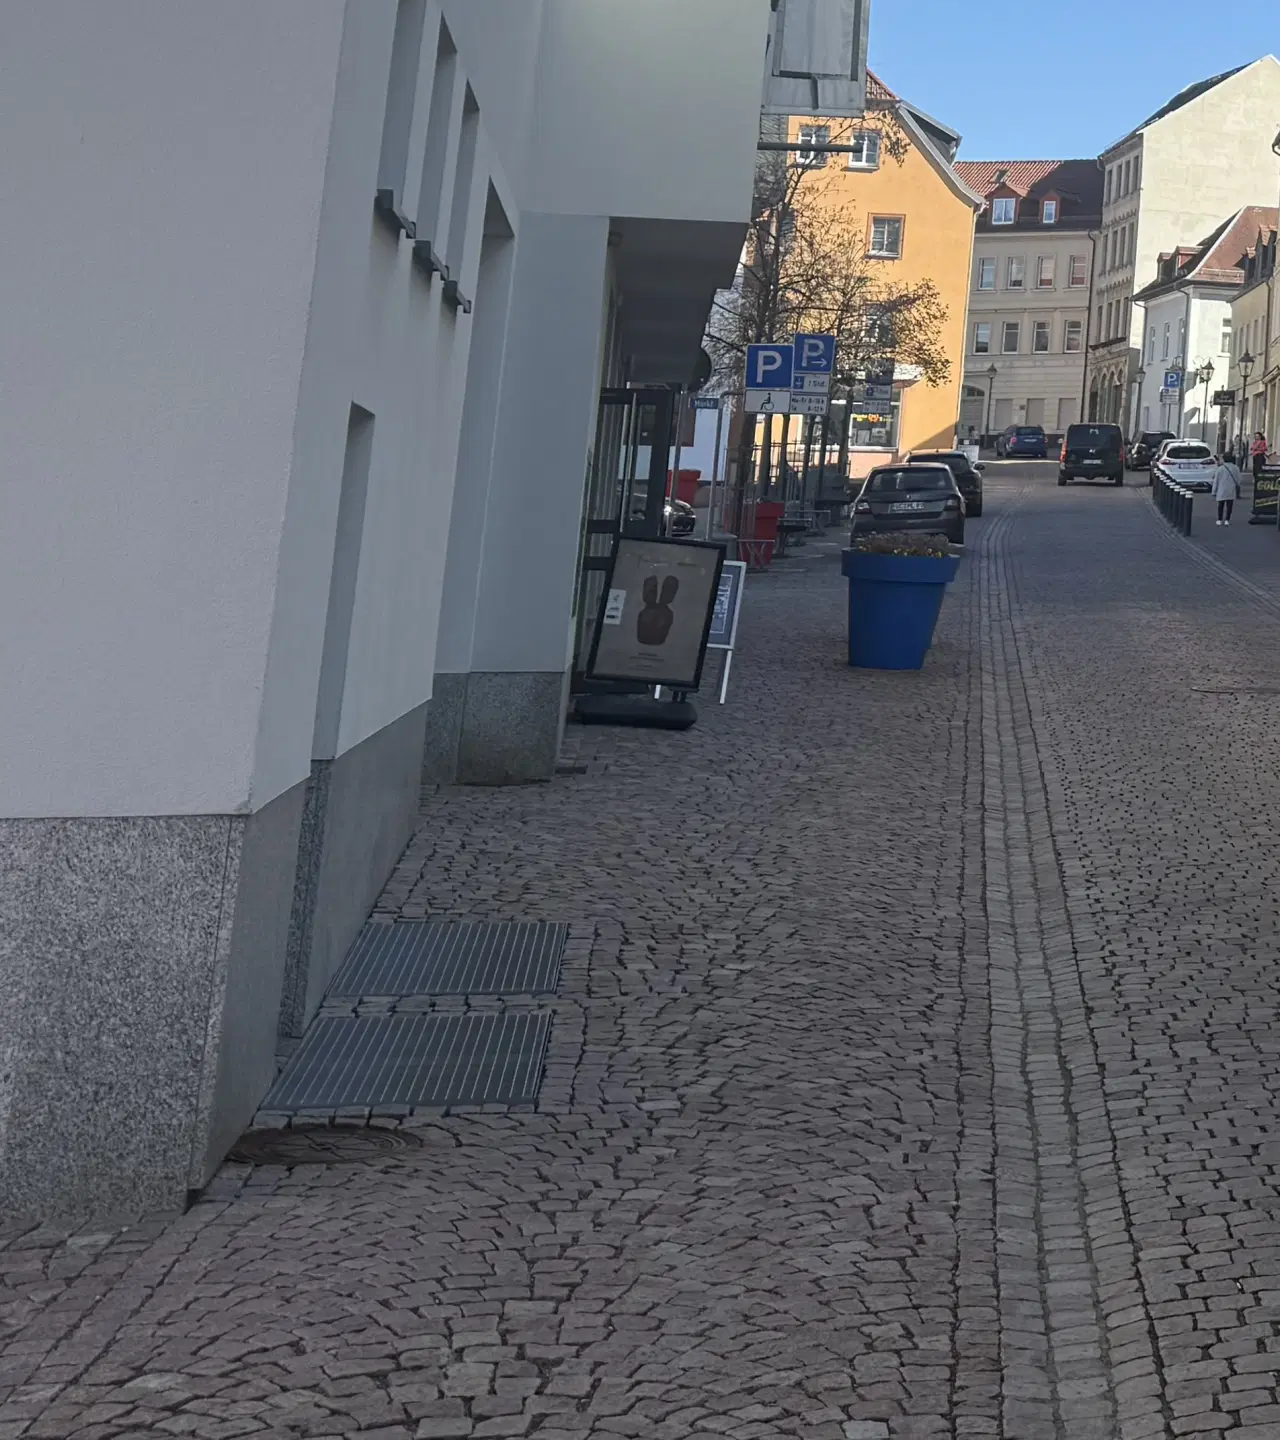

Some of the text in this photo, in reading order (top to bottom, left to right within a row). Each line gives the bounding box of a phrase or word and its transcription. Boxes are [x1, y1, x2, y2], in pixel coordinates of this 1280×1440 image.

[756, 350, 783, 383] P
[801, 339, 825, 367] P
[1167, 373, 1177, 385] P
